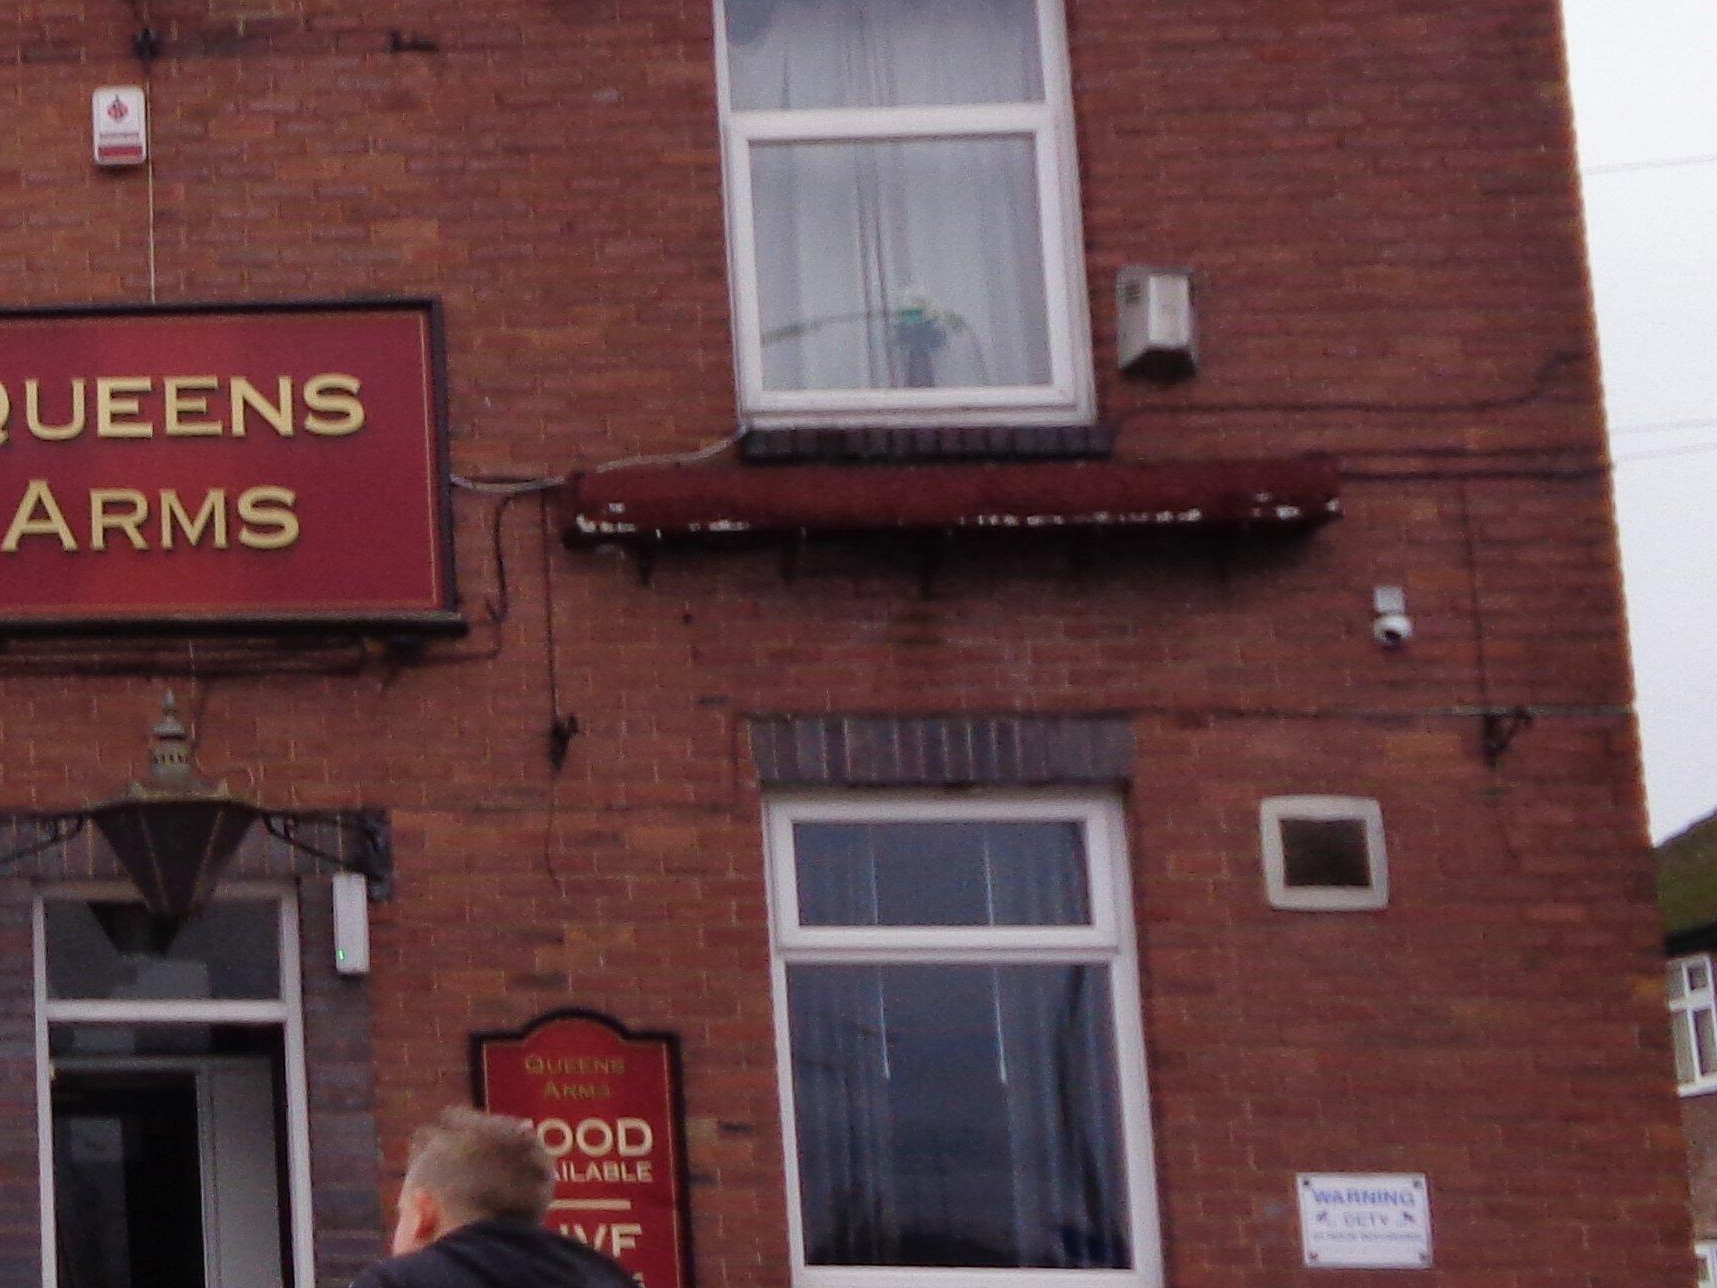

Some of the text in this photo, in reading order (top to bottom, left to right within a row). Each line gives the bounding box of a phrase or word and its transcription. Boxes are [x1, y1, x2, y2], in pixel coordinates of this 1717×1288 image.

[0, 479, 301, 552] ARMS
[519, 1117, 653, 1158] OOD
[1312, 1188, 1415, 1206] WARNING
